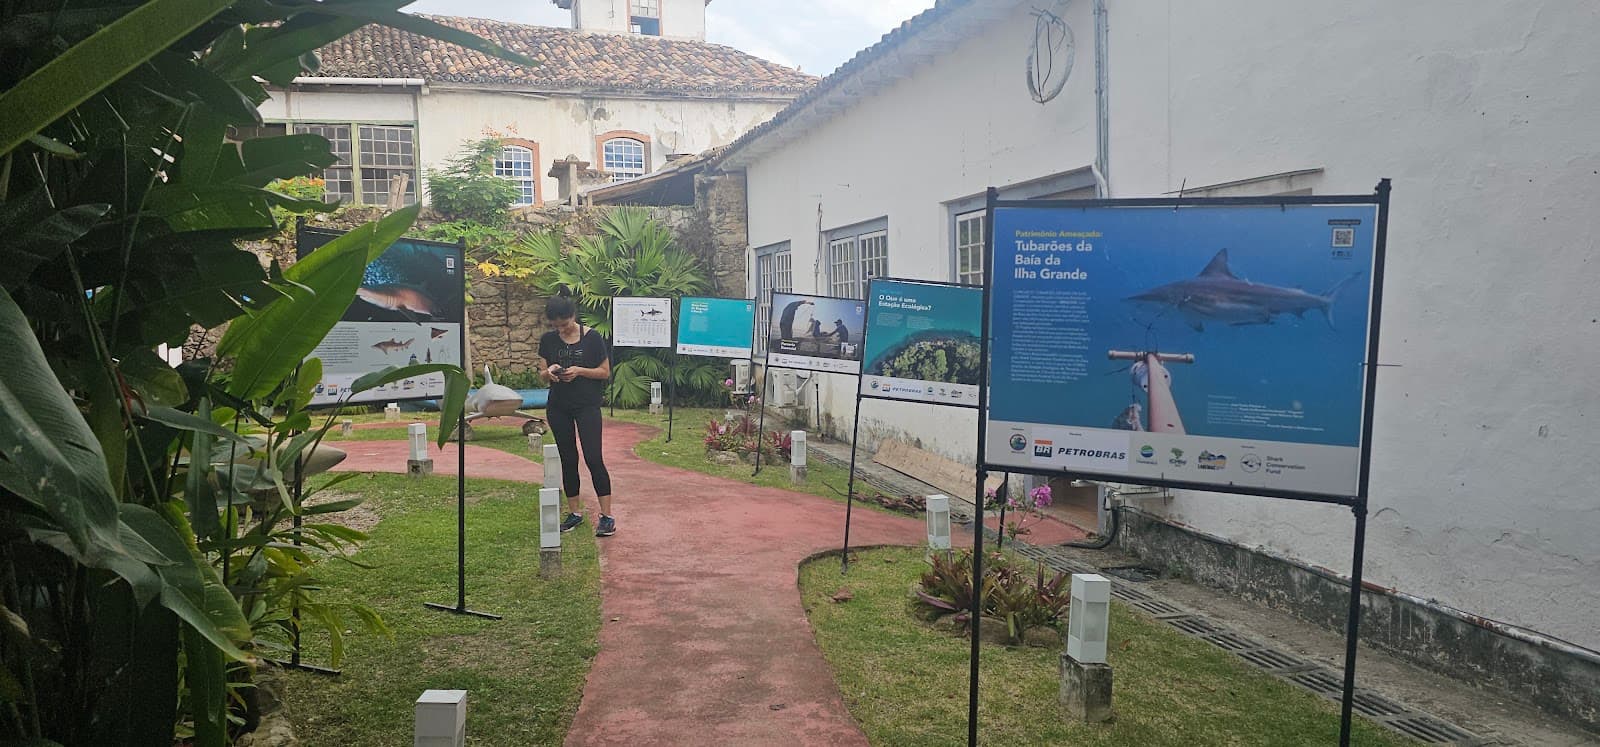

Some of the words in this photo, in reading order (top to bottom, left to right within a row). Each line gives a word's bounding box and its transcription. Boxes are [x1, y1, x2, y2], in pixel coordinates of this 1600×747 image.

[1015, 240, 1073, 252] Tubarões
[1076, 240, 1093, 252] da
[1014, 254, 1041, 266] Baía
[1044, 254, 1061, 266] da
[1014, 267, 1037, 280] Ilha
[1040, 268, 1088, 281] Grande
[878, 301, 900, 309] Estação
[901, 302, 932, 311] Ecológica?
[1057, 446, 1126, 460] PETROBRAS
